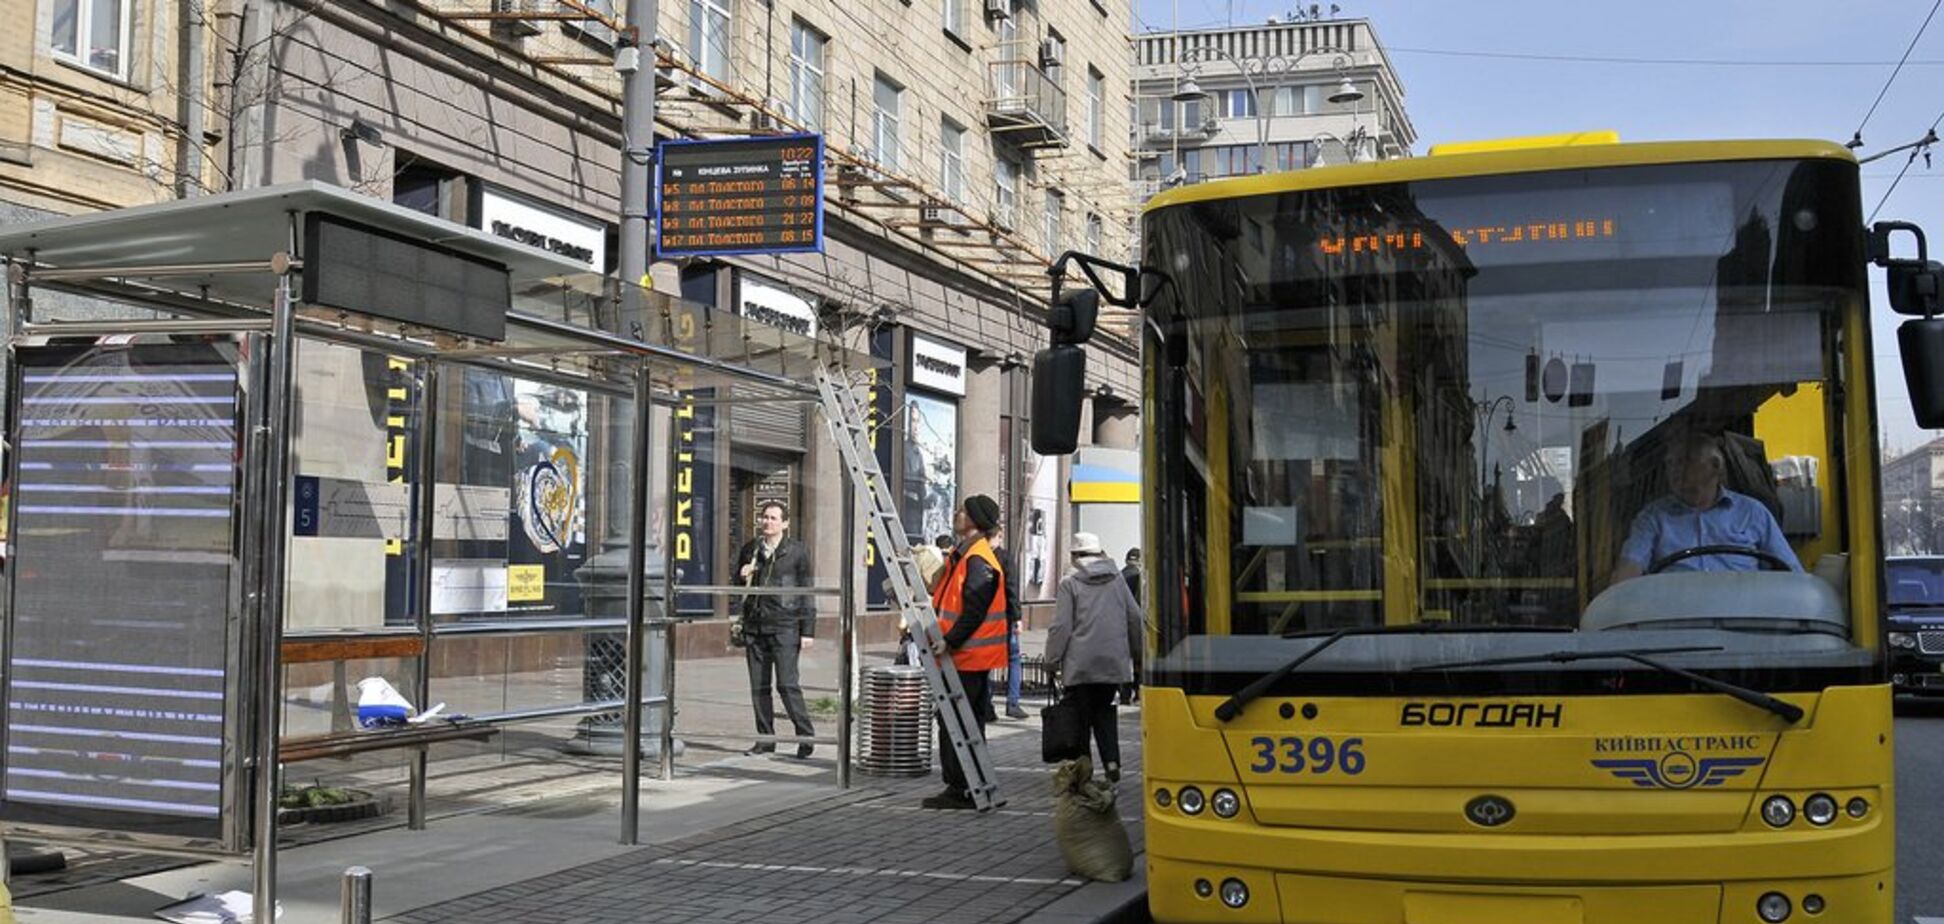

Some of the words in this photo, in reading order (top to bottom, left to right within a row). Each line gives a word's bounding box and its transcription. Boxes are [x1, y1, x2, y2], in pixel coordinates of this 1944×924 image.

[801, 212, 814, 224] 27
[802, 229, 813, 241] 15
[300, 508, 311, 527] 5
[1400, 703, 1562, 728] БОГДАН
[1595, 735, 1761, 752] КИЇВПАСТРАНС
[1250, 737, 1366, 775] 3396
